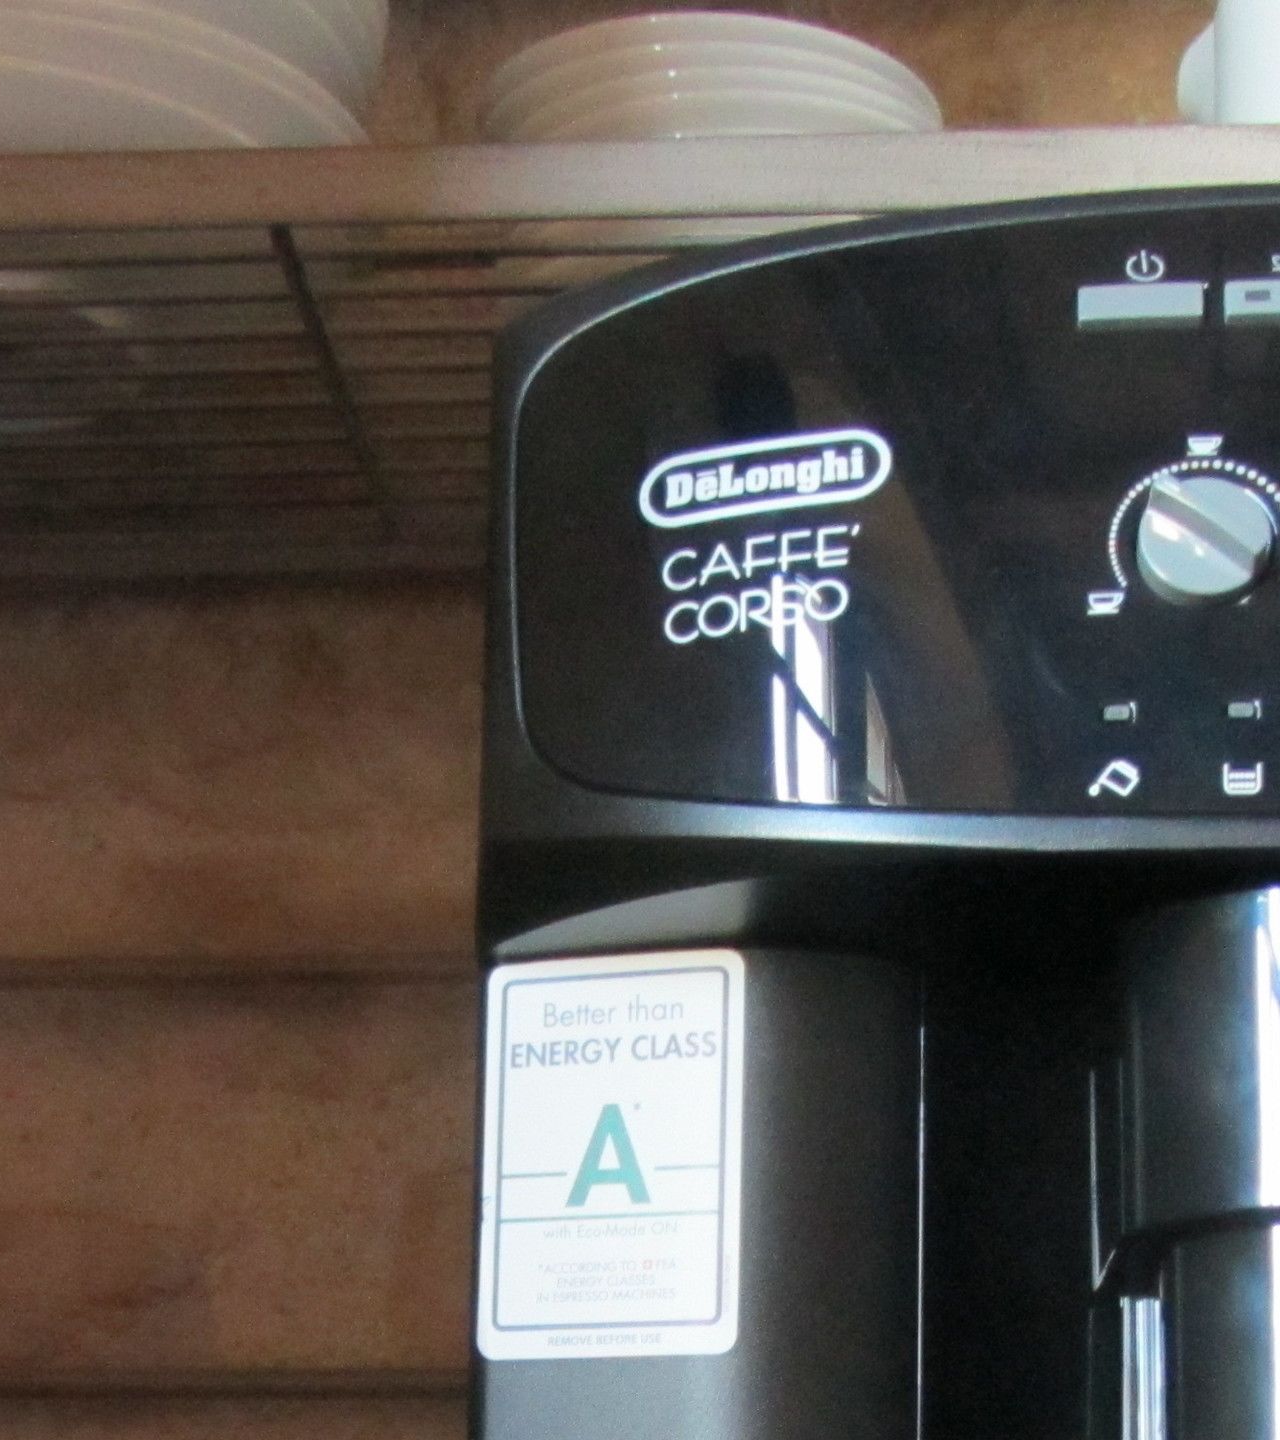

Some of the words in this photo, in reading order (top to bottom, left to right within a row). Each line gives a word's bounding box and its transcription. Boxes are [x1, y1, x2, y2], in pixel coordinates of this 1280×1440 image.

[664, 579, 849, 644] CORSO
[542, 1000, 617, 1029] Better
[627, 993, 685, 1023] than
[509, 1036, 624, 1070] ENERGY
[630, 1030, 718, 1062] CLASS
[542, 1224, 572, 1240] with
[650, 1220, 679, 1236] ON
[620, 1259, 637, 1273] TO
[556, 1275, 604, 1289] ENERGY
[606, 1273, 656, 1288] CLASSES
[536, 1291, 550, 1304] IN
[552, 1289, 610, 1304] ESPRESSO
[611, 1287, 677, 1303] MACHINES
[547, 1334, 593, 1347] REMOVE
[595, 1333, 637, 1346] BEFORE
[640, 1332, 662, 1345] USE
